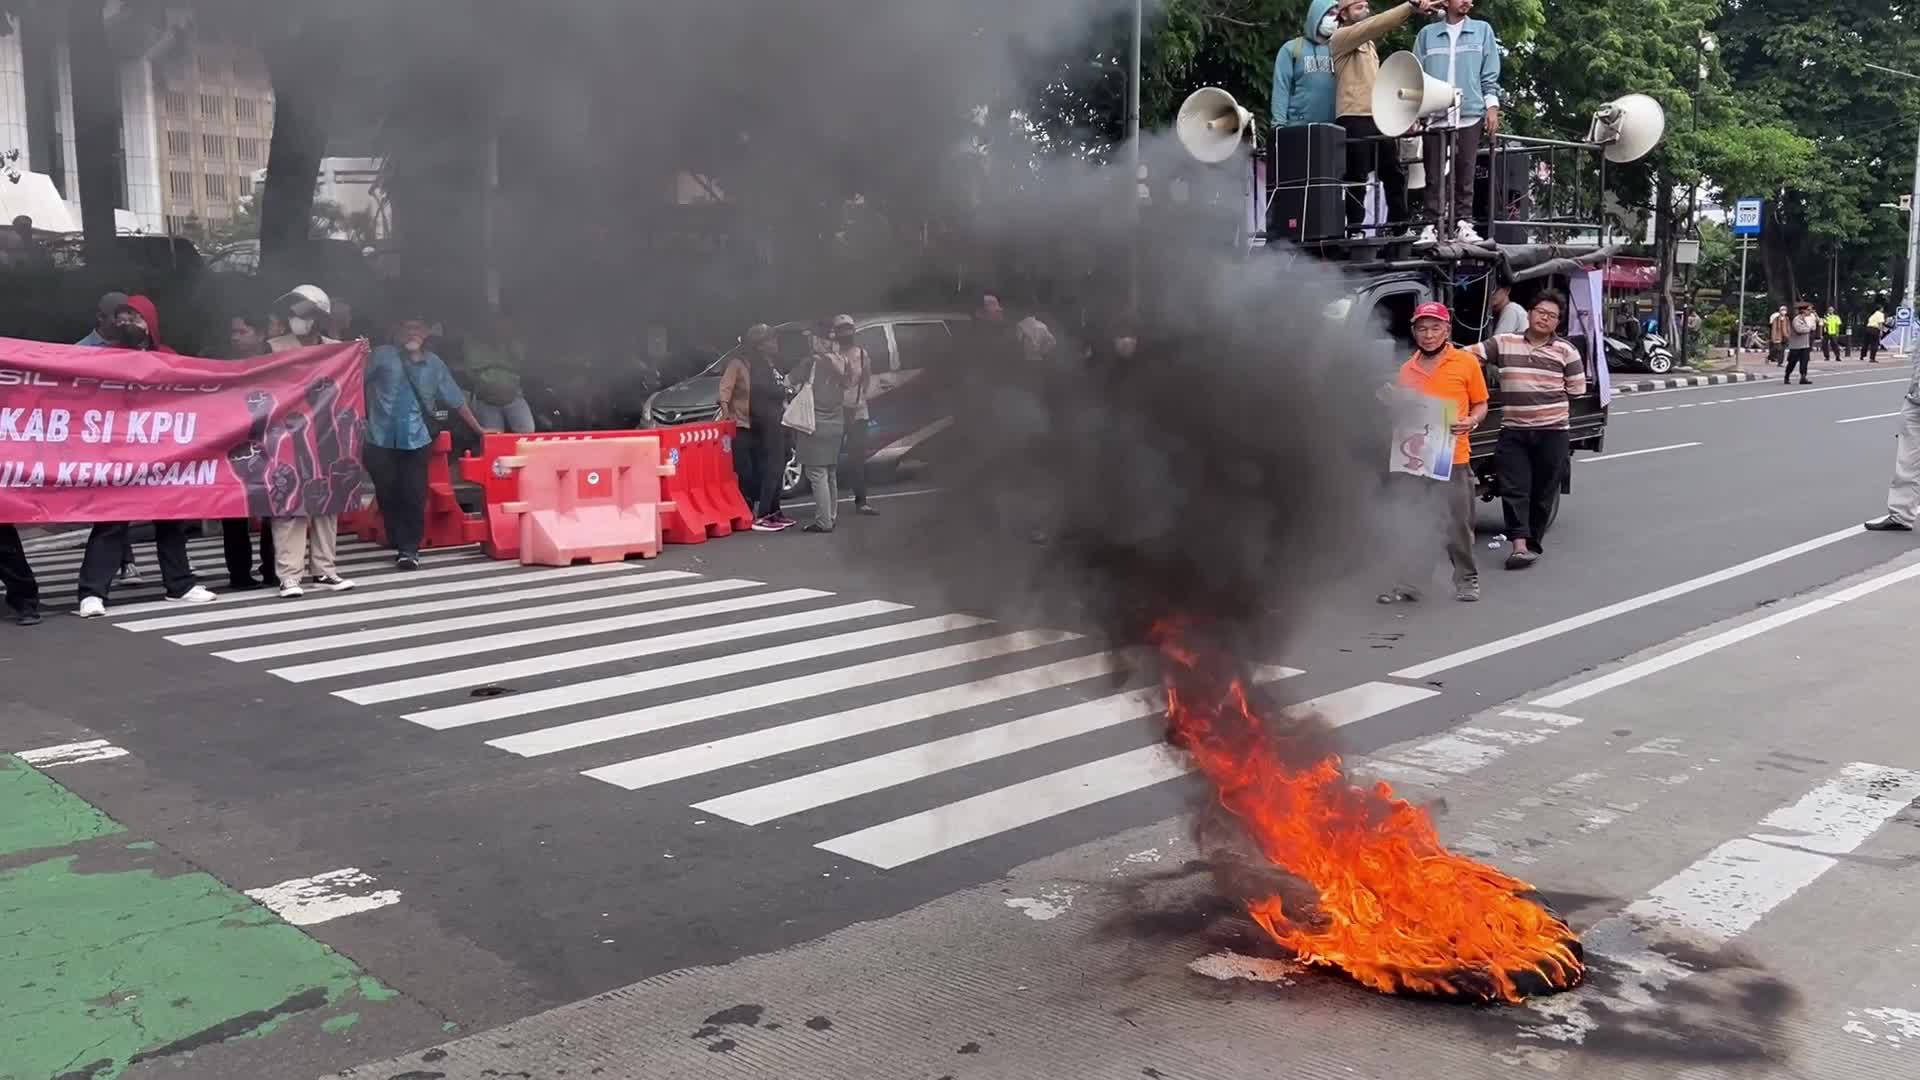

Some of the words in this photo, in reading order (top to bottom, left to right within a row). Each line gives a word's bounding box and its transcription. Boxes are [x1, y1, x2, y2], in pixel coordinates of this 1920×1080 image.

[1739, 213, 1757, 223] STOP
[0, 407, 71, 442] KAB
[81, 409, 115, 444] SI
[126, 411, 197, 444] KPU
[0, 461, 46, 488] ILA
[53, 459, 219, 488] KEKUASAAN
